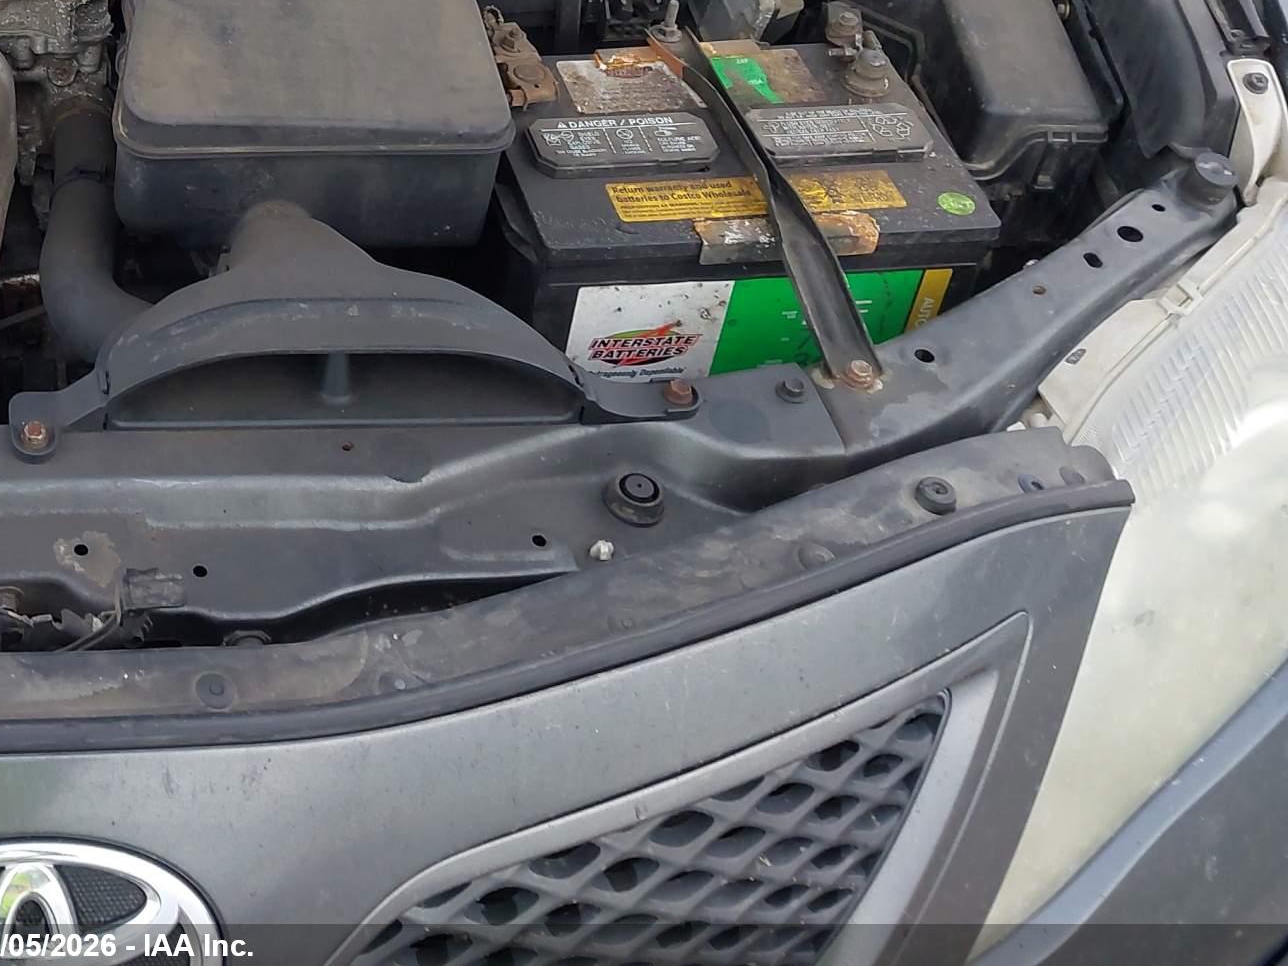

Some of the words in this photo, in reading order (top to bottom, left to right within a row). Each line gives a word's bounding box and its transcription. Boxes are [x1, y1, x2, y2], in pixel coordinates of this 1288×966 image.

[568, 118, 616, 129] DANGER
[628, 116, 674, 126] POISON
[612, 186, 645, 194] Return
[646, 183, 688, 193] warranty
[689, 182, 708, 190] and
[616, 194, 658, 203] batteries
[672, 192, 701, 200] Costco
[703, 189, 751, 199] Wholesale
[591, 335, 697, 349] INTERSTATE
[592, 346, 685, 359] BATTERIES
